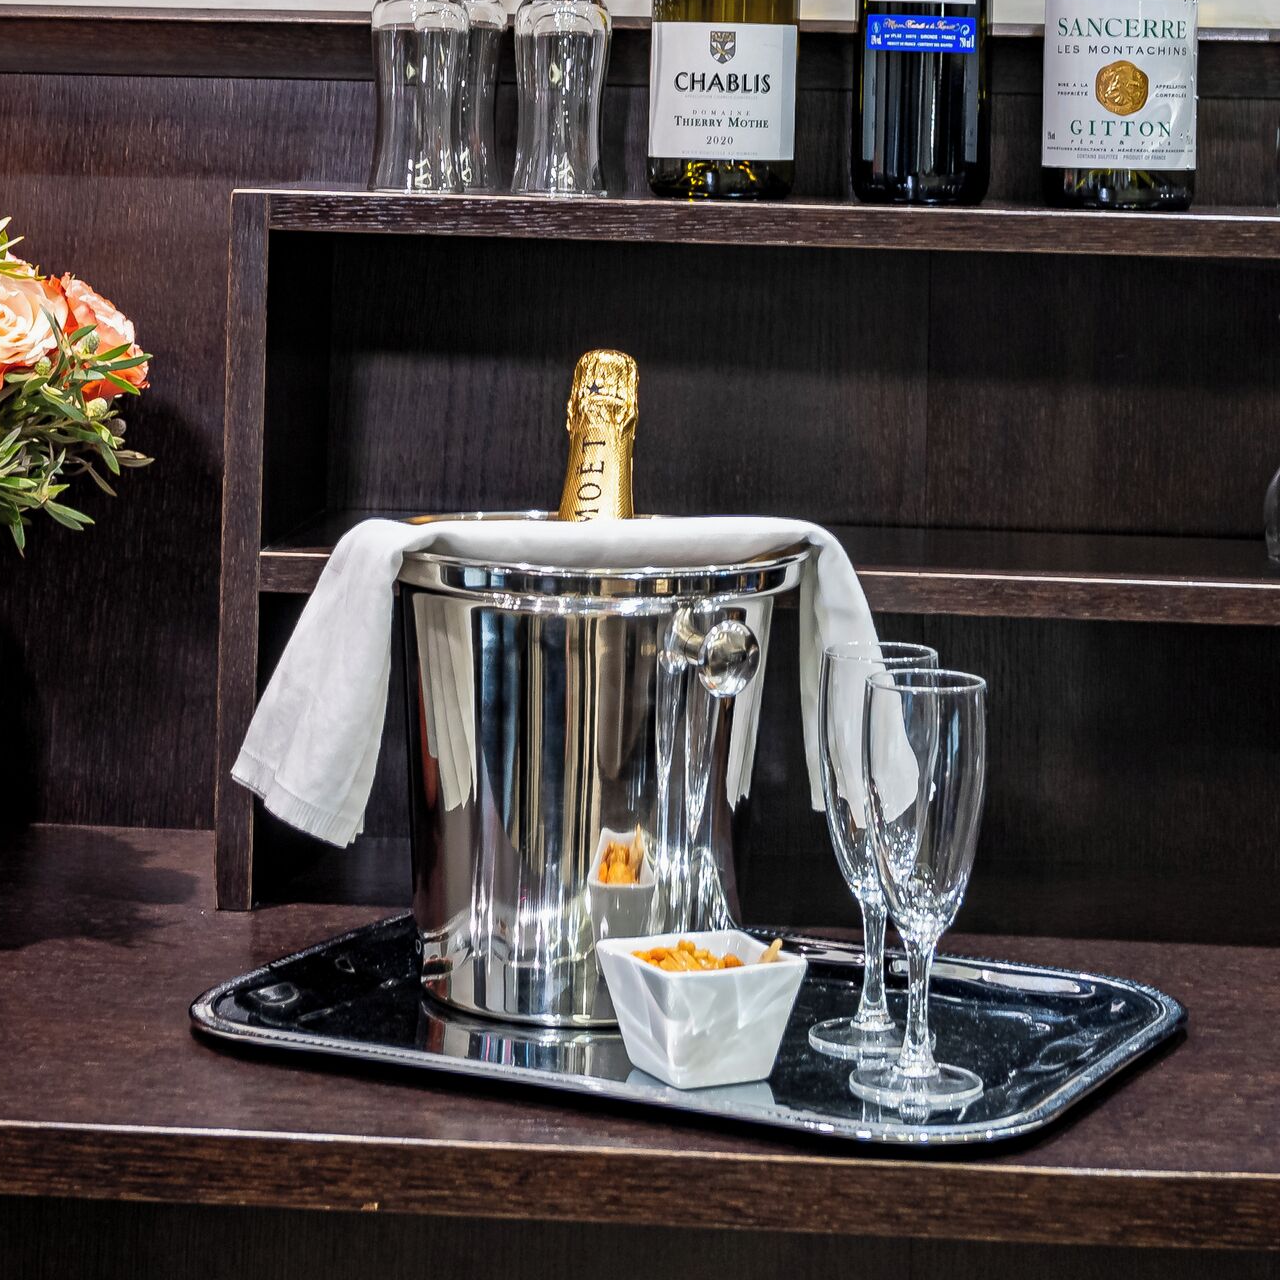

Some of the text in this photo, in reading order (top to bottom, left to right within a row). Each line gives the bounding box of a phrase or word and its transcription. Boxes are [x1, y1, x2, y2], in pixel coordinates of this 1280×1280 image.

[1057, 17, 1188, 40] SANCERRE
[1057, 44, 1188, 57] LES MONTACHINS
[673, 71, 771, 95] CHABLIS
[692, 109, 752, 117] DOMAINE
[1070, 119, 1172, 138] GITTON
[705, 135, 734, 146] 2020
